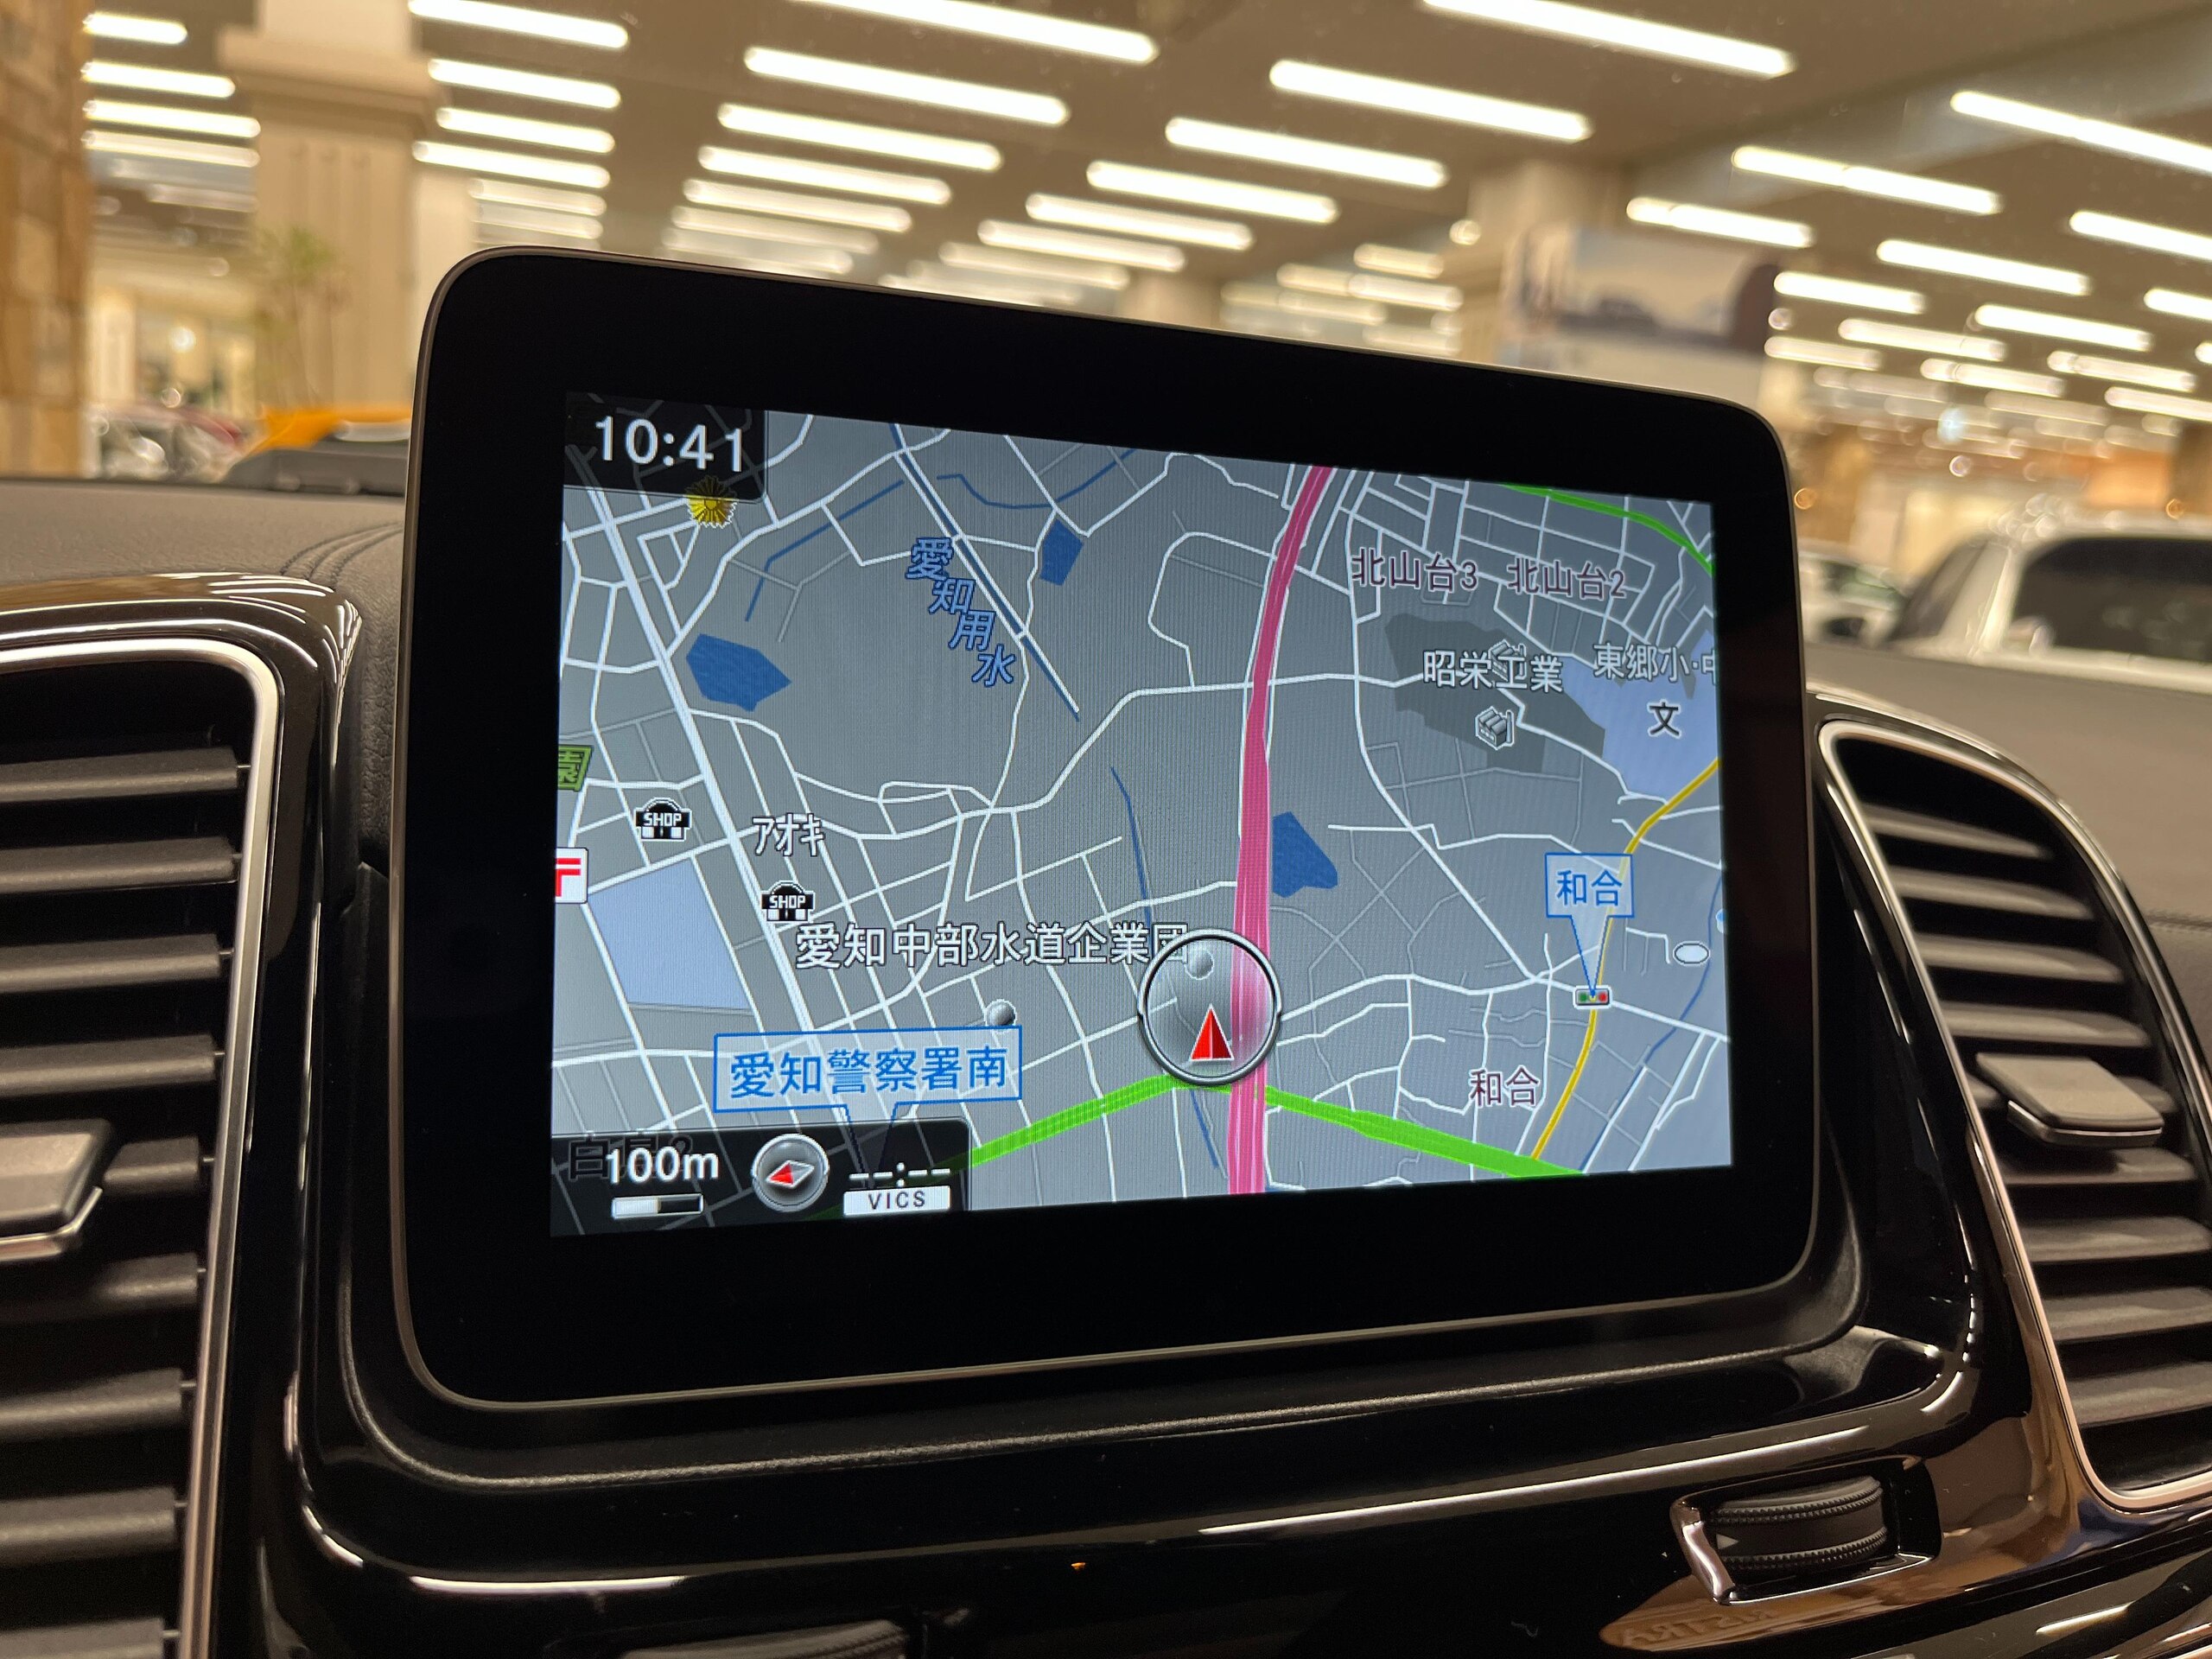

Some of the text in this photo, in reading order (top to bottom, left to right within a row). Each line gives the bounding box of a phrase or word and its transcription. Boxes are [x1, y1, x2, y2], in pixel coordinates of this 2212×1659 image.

[595, 416, 743, 473] 10:41
[1351, 547, 1479, 593] 北山台3
[1508, 556, 1626, 601] 北山台2
[906, 537, 1016, 686] 愛知用水
[1422, 650, 1564, 693] 昭栄工業
[1648, 701, 1681, 737] 文
[644, 812, 682, 827] SHOP
[753, 812, 824, 856] アオキ
[769, 895, 806, 909] SHOP
[1555, 869, 1624, 908] 和合
[730, 1045, 1007, 1098] 愛知警察署南
[1470, 1065, 1541, 1108] 和合
[606, 1146, 719, 1185] 100m
[868, 1191, 925, 1210] VICS
